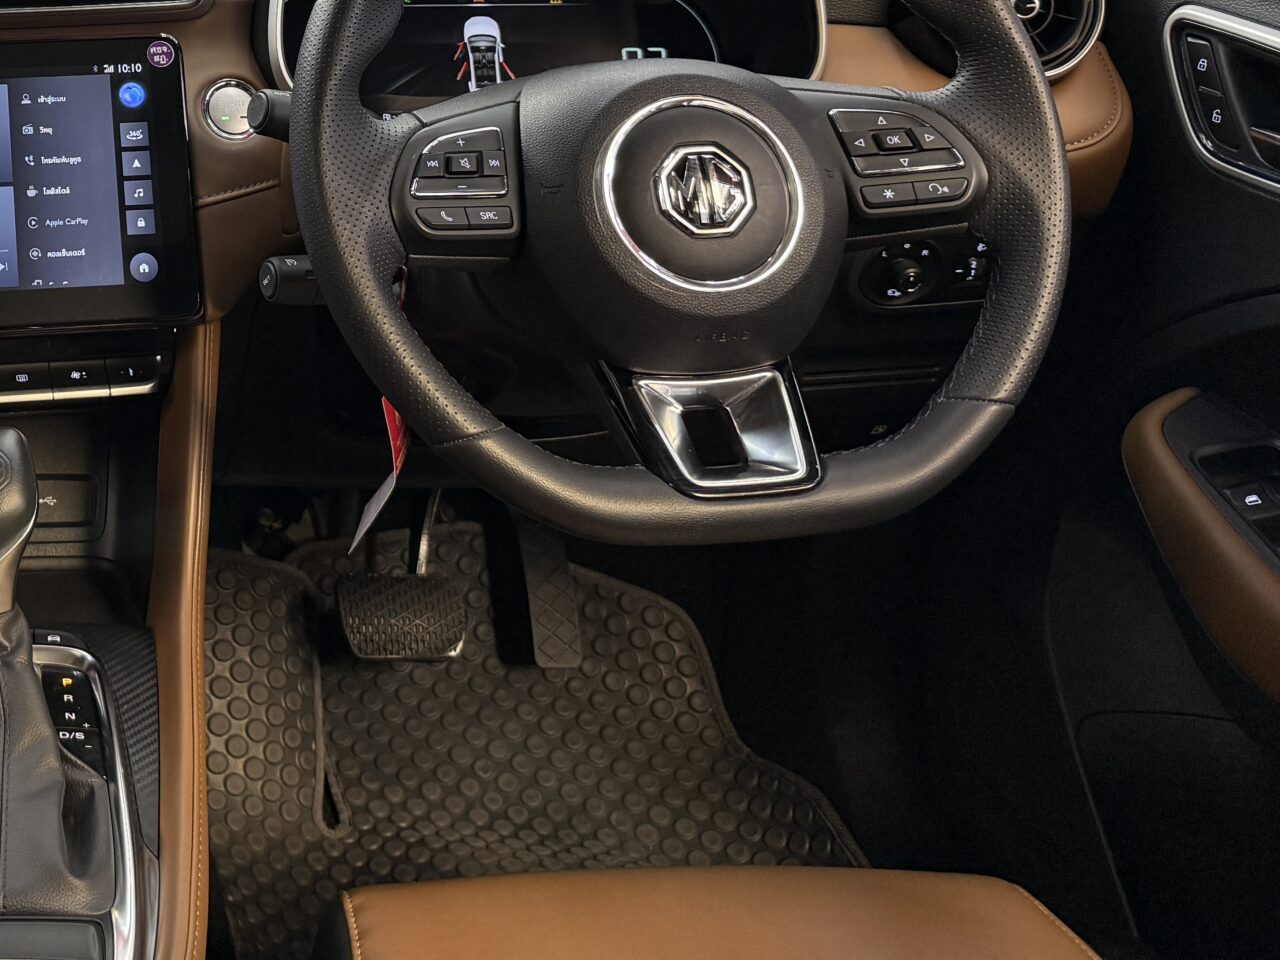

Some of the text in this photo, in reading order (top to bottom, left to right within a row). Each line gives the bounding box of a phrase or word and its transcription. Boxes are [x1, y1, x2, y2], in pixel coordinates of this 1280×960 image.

[117, 63, 142, 73] 10:10
[886, 136, 902, 145] OK
[479, 211, 498, 220] SRC
[45, 218, 89, 228] Apple CarPlay
[62, 677, 73, 687] P
[63, 694, 74, 703] R
[64, 712, 76, 721] N
[59, 731, 85, 740] D/S
